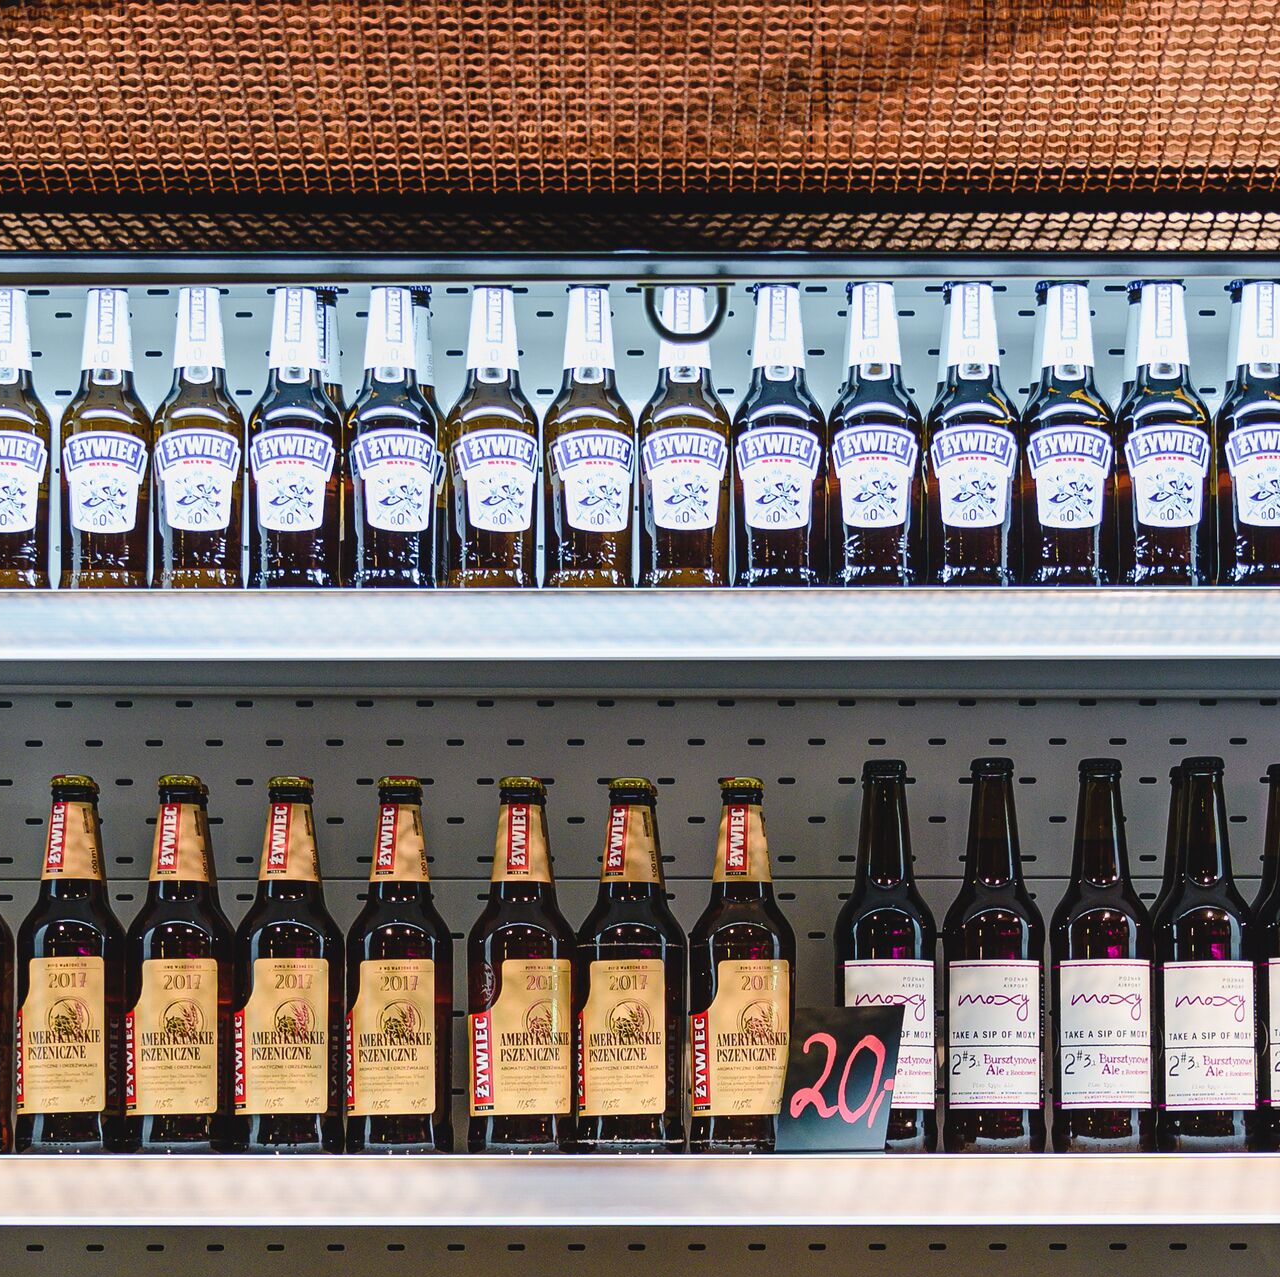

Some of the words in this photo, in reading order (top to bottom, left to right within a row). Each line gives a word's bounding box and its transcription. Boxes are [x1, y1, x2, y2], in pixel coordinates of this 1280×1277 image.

[165, 435, 233, 459] ŻYWIEC
[368, 437, 432, 459] ŻYWIEC
[567, 436, 632, 460] ŻYWIEC
[746, 433, 810, 457] ŻYWIEC
[940, 432, 1008, 456] ŻYWIEC
[1135, 433, 1201, 456] ŻYWIEC
[49, 804, 66, 865] ŻYWIEC
[269, 806, 288, 867] ŻYWIEC
[510, 807, 527, 866] ŻYWIEC
[727, 808, 744, 867] ŻYWIEC
[380, 976, 419, 991] 2017
[958, 994, 1029, 1021] moxy
[1071, 994, 1142, 1021] moxy
[952, 1031, 970, 1039] TAKE
[1016, 1031, 1035, 1039] MOXY
[359, 1048, 417, 1062] PSZENICZNE
[476, 1017, 490, 1098] ŻYWIEC
[986, 1063, 1004, 1076] Ale
